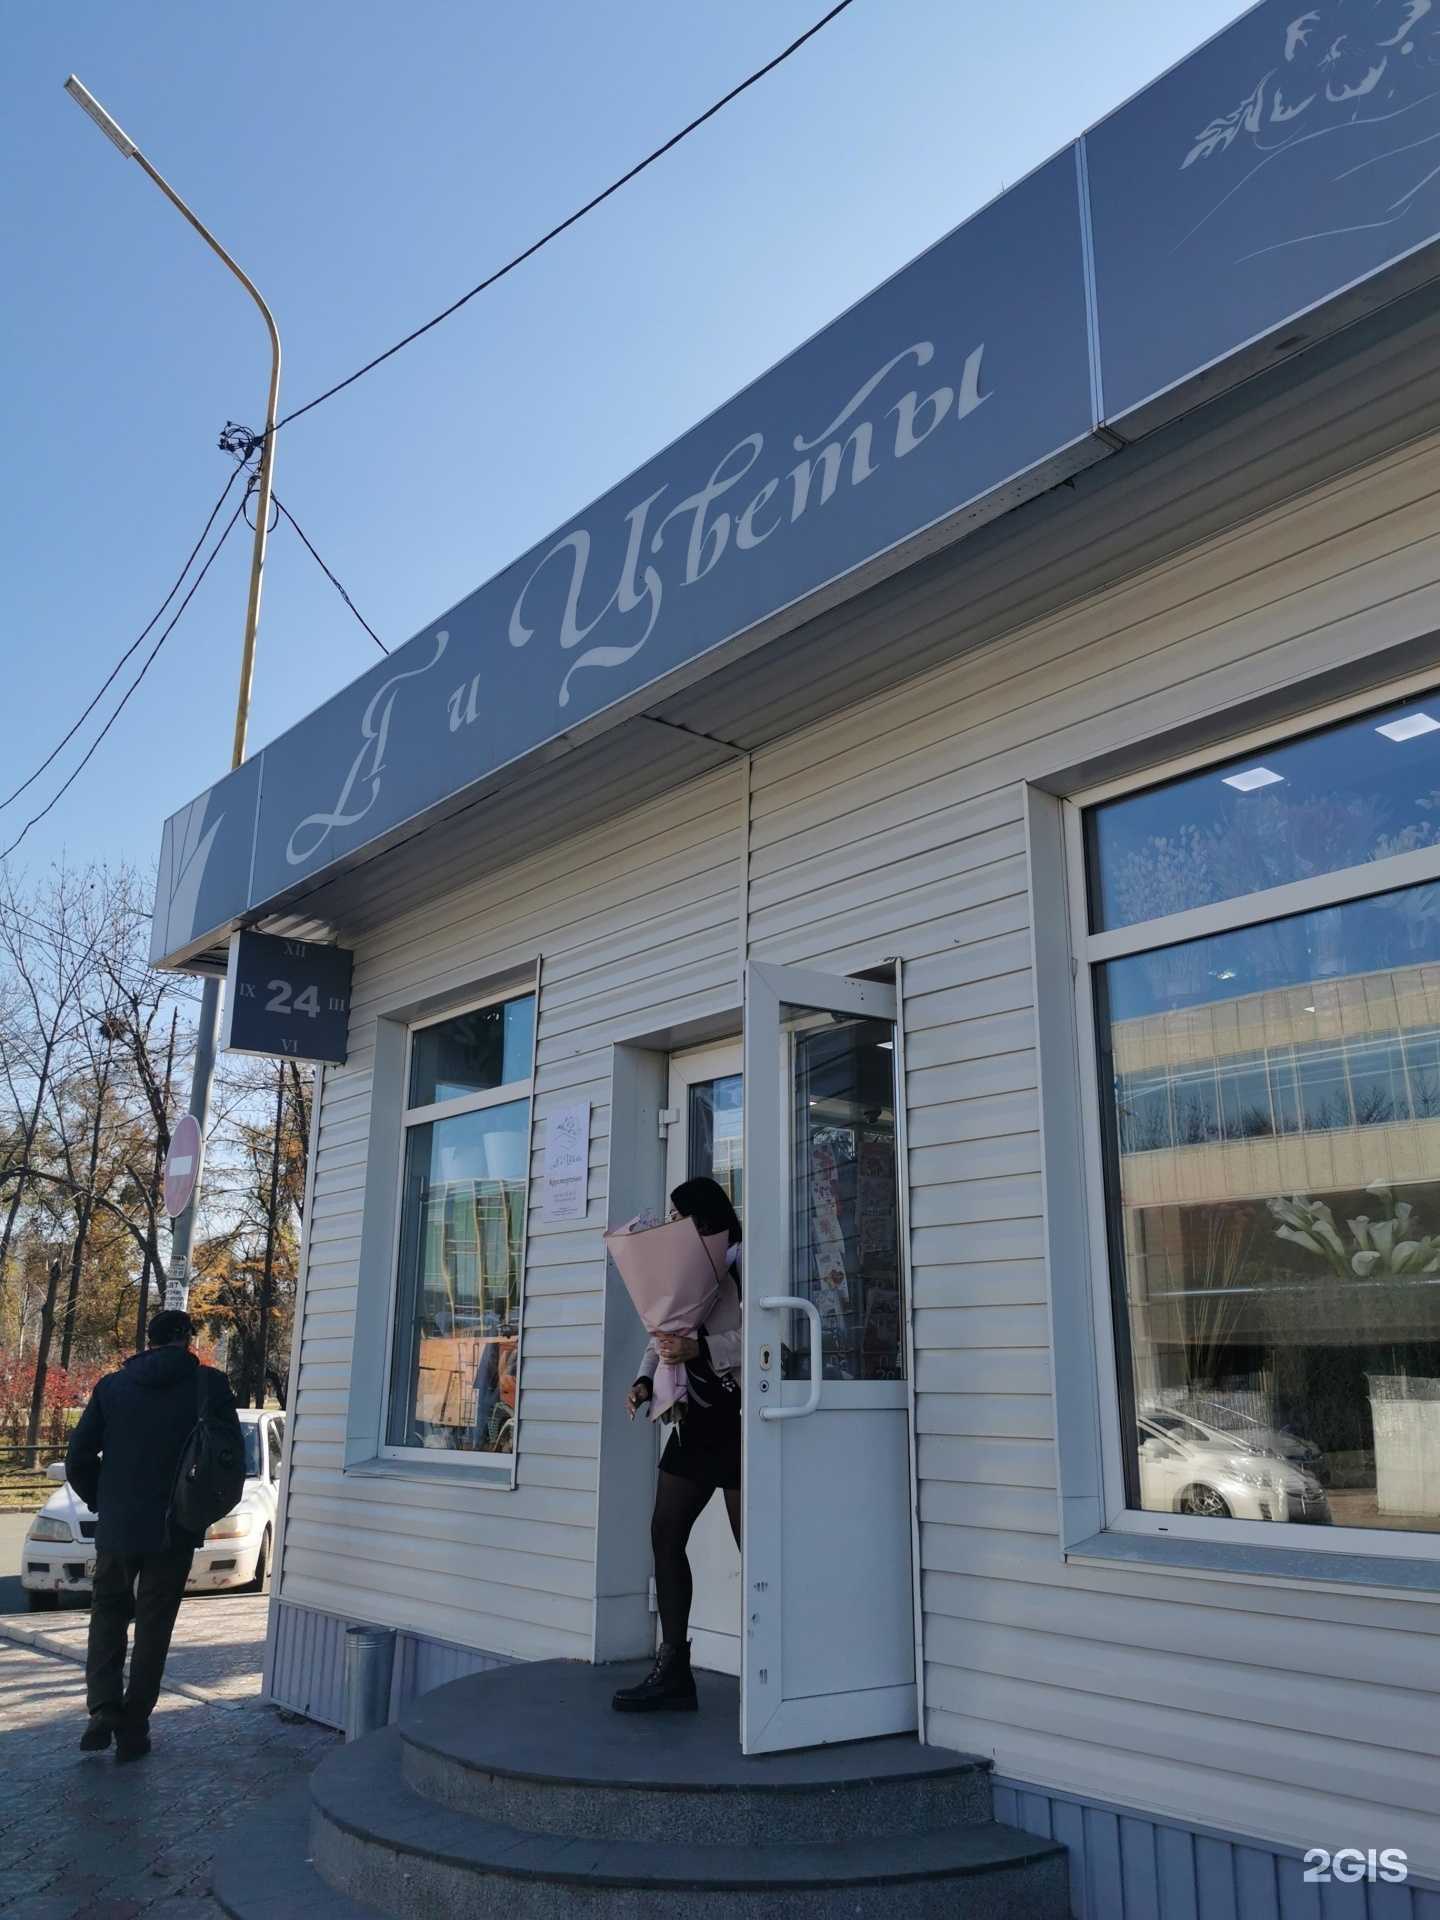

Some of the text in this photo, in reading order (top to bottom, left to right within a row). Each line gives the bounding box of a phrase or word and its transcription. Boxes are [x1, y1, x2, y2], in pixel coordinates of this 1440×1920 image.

[286, 341, 994, 864] Я и Цветы
[265, 979, 320, 1018] 24
